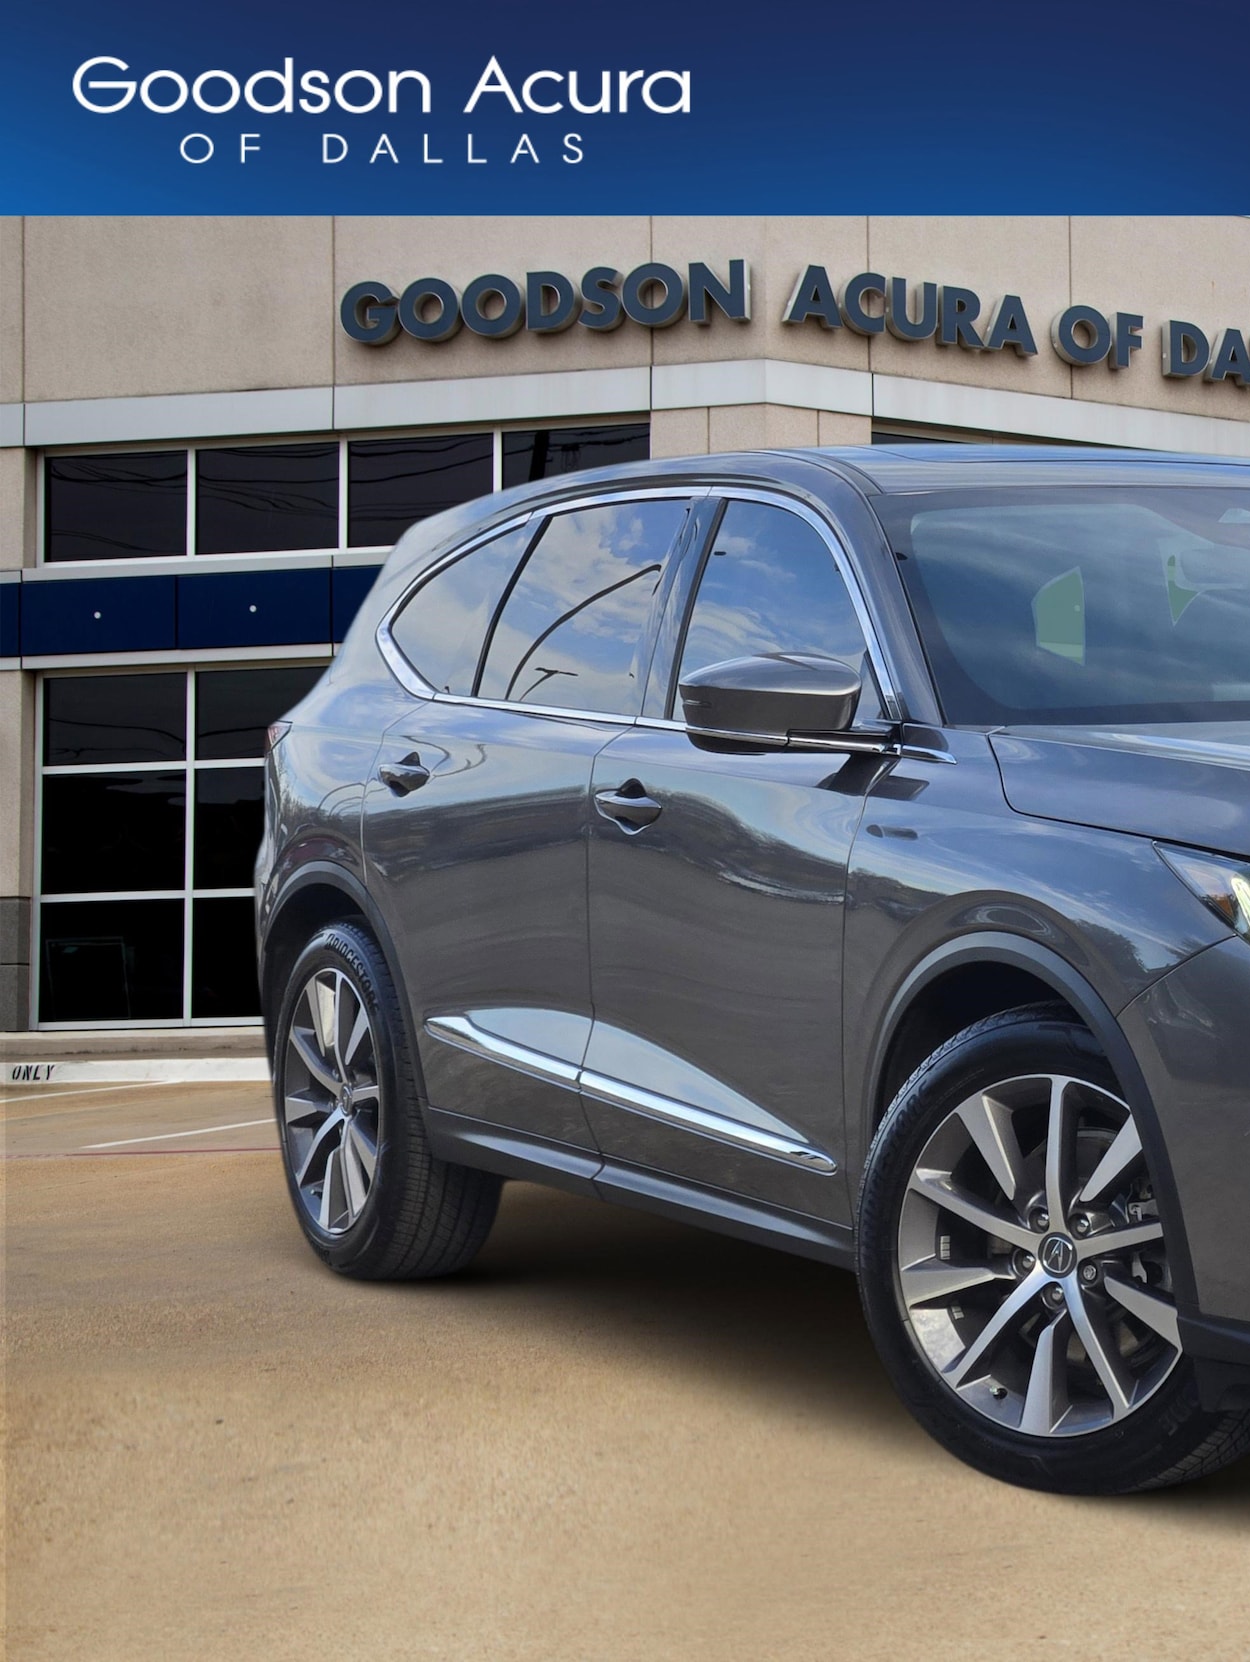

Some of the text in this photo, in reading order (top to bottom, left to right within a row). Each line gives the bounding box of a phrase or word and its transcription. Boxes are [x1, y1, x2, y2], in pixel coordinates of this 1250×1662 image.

[339, 258, 751, 346] GOODSON
[782, 264, 1038, 357] ACURA
[1051, 304, 1144, 370] OF
[11, 1064, 55, 1081] ONLY
